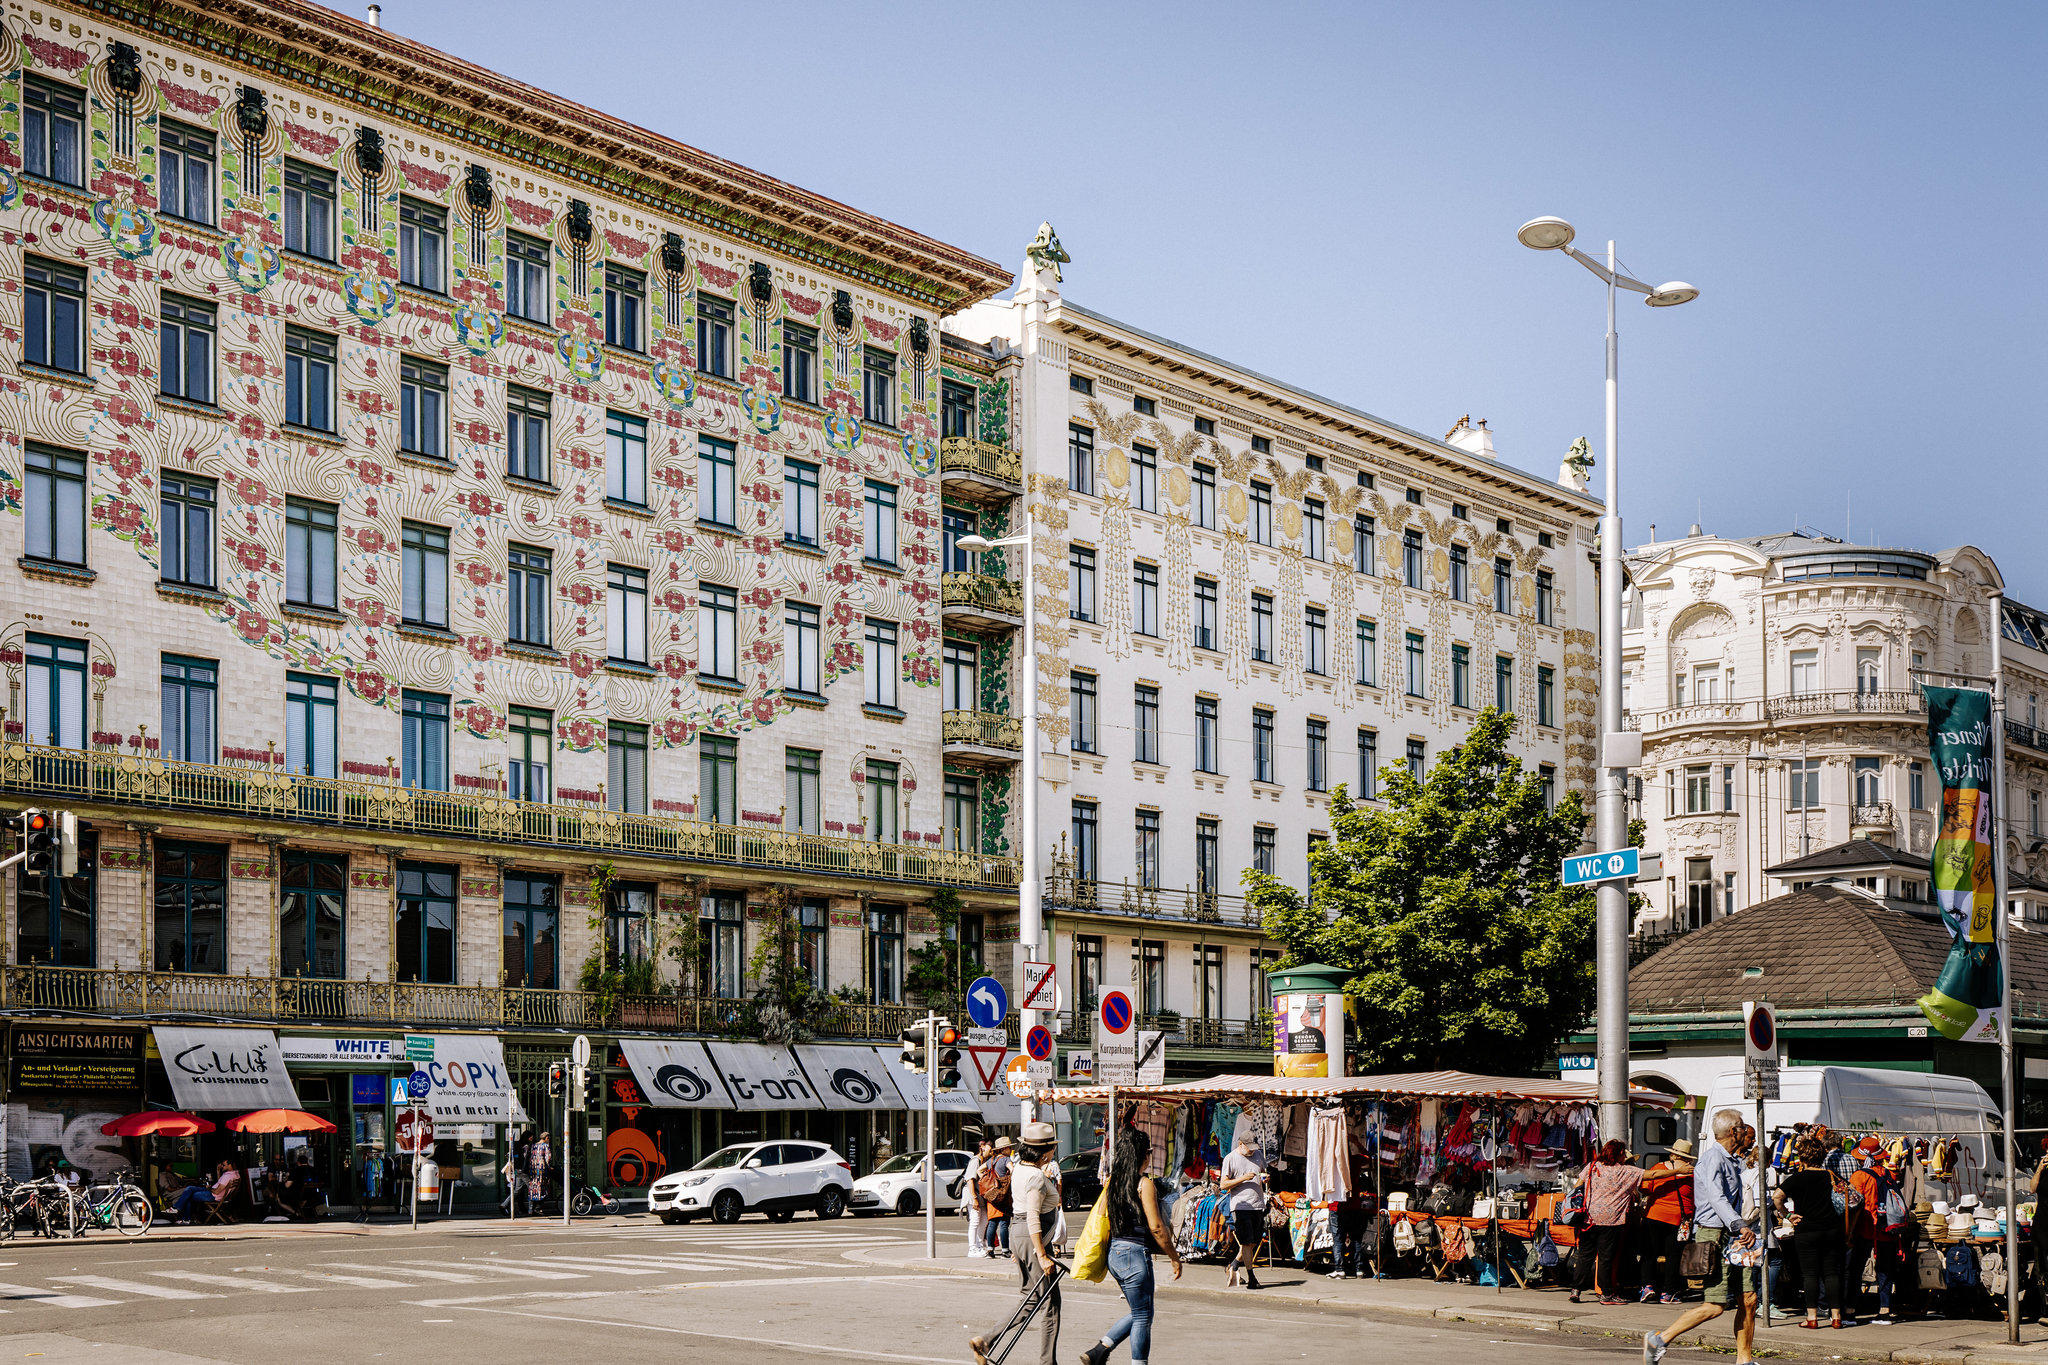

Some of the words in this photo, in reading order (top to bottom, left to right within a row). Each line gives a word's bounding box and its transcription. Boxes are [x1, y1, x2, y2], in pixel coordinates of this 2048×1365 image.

[1577, 858, 1602, 879] WC
[1026, 968, 1053, 983] Markt-
[1026, 989, 1053, 1004] gebiet
[1909, 1028, 1915, 1036] C
[1916, 1028, 1926, 1036] 20
[18, 1033, 133, 1049] ANSICHTSKARTEN
[335, 1039, 390, 1053] WHITE
[282, 1051, 328, 1060] ÜBERSETZUNGSBÜRO
[329, 1052, 339, 1060] FÜR
[1100, 1043, 1134, 1056] Kurzparkzone
[1074, 1055, 1091, 1070] dm
[1562, 1056, 1579, 1068] WC
[88, 1065, 135, 1073] Versteigerung
[428, 1061, 500, 1089] COPY
[787, 1068, 800, 1077] .at
[192, 1076, 269, 1085] KUISHIMBO
[728, 1073, 811, 1100] t-on
[436, 1089, 508, 1098] white.copy@aon.at
[435, 1105, 462, 1116] und
[465, 1105, 499, 1116] mehr
